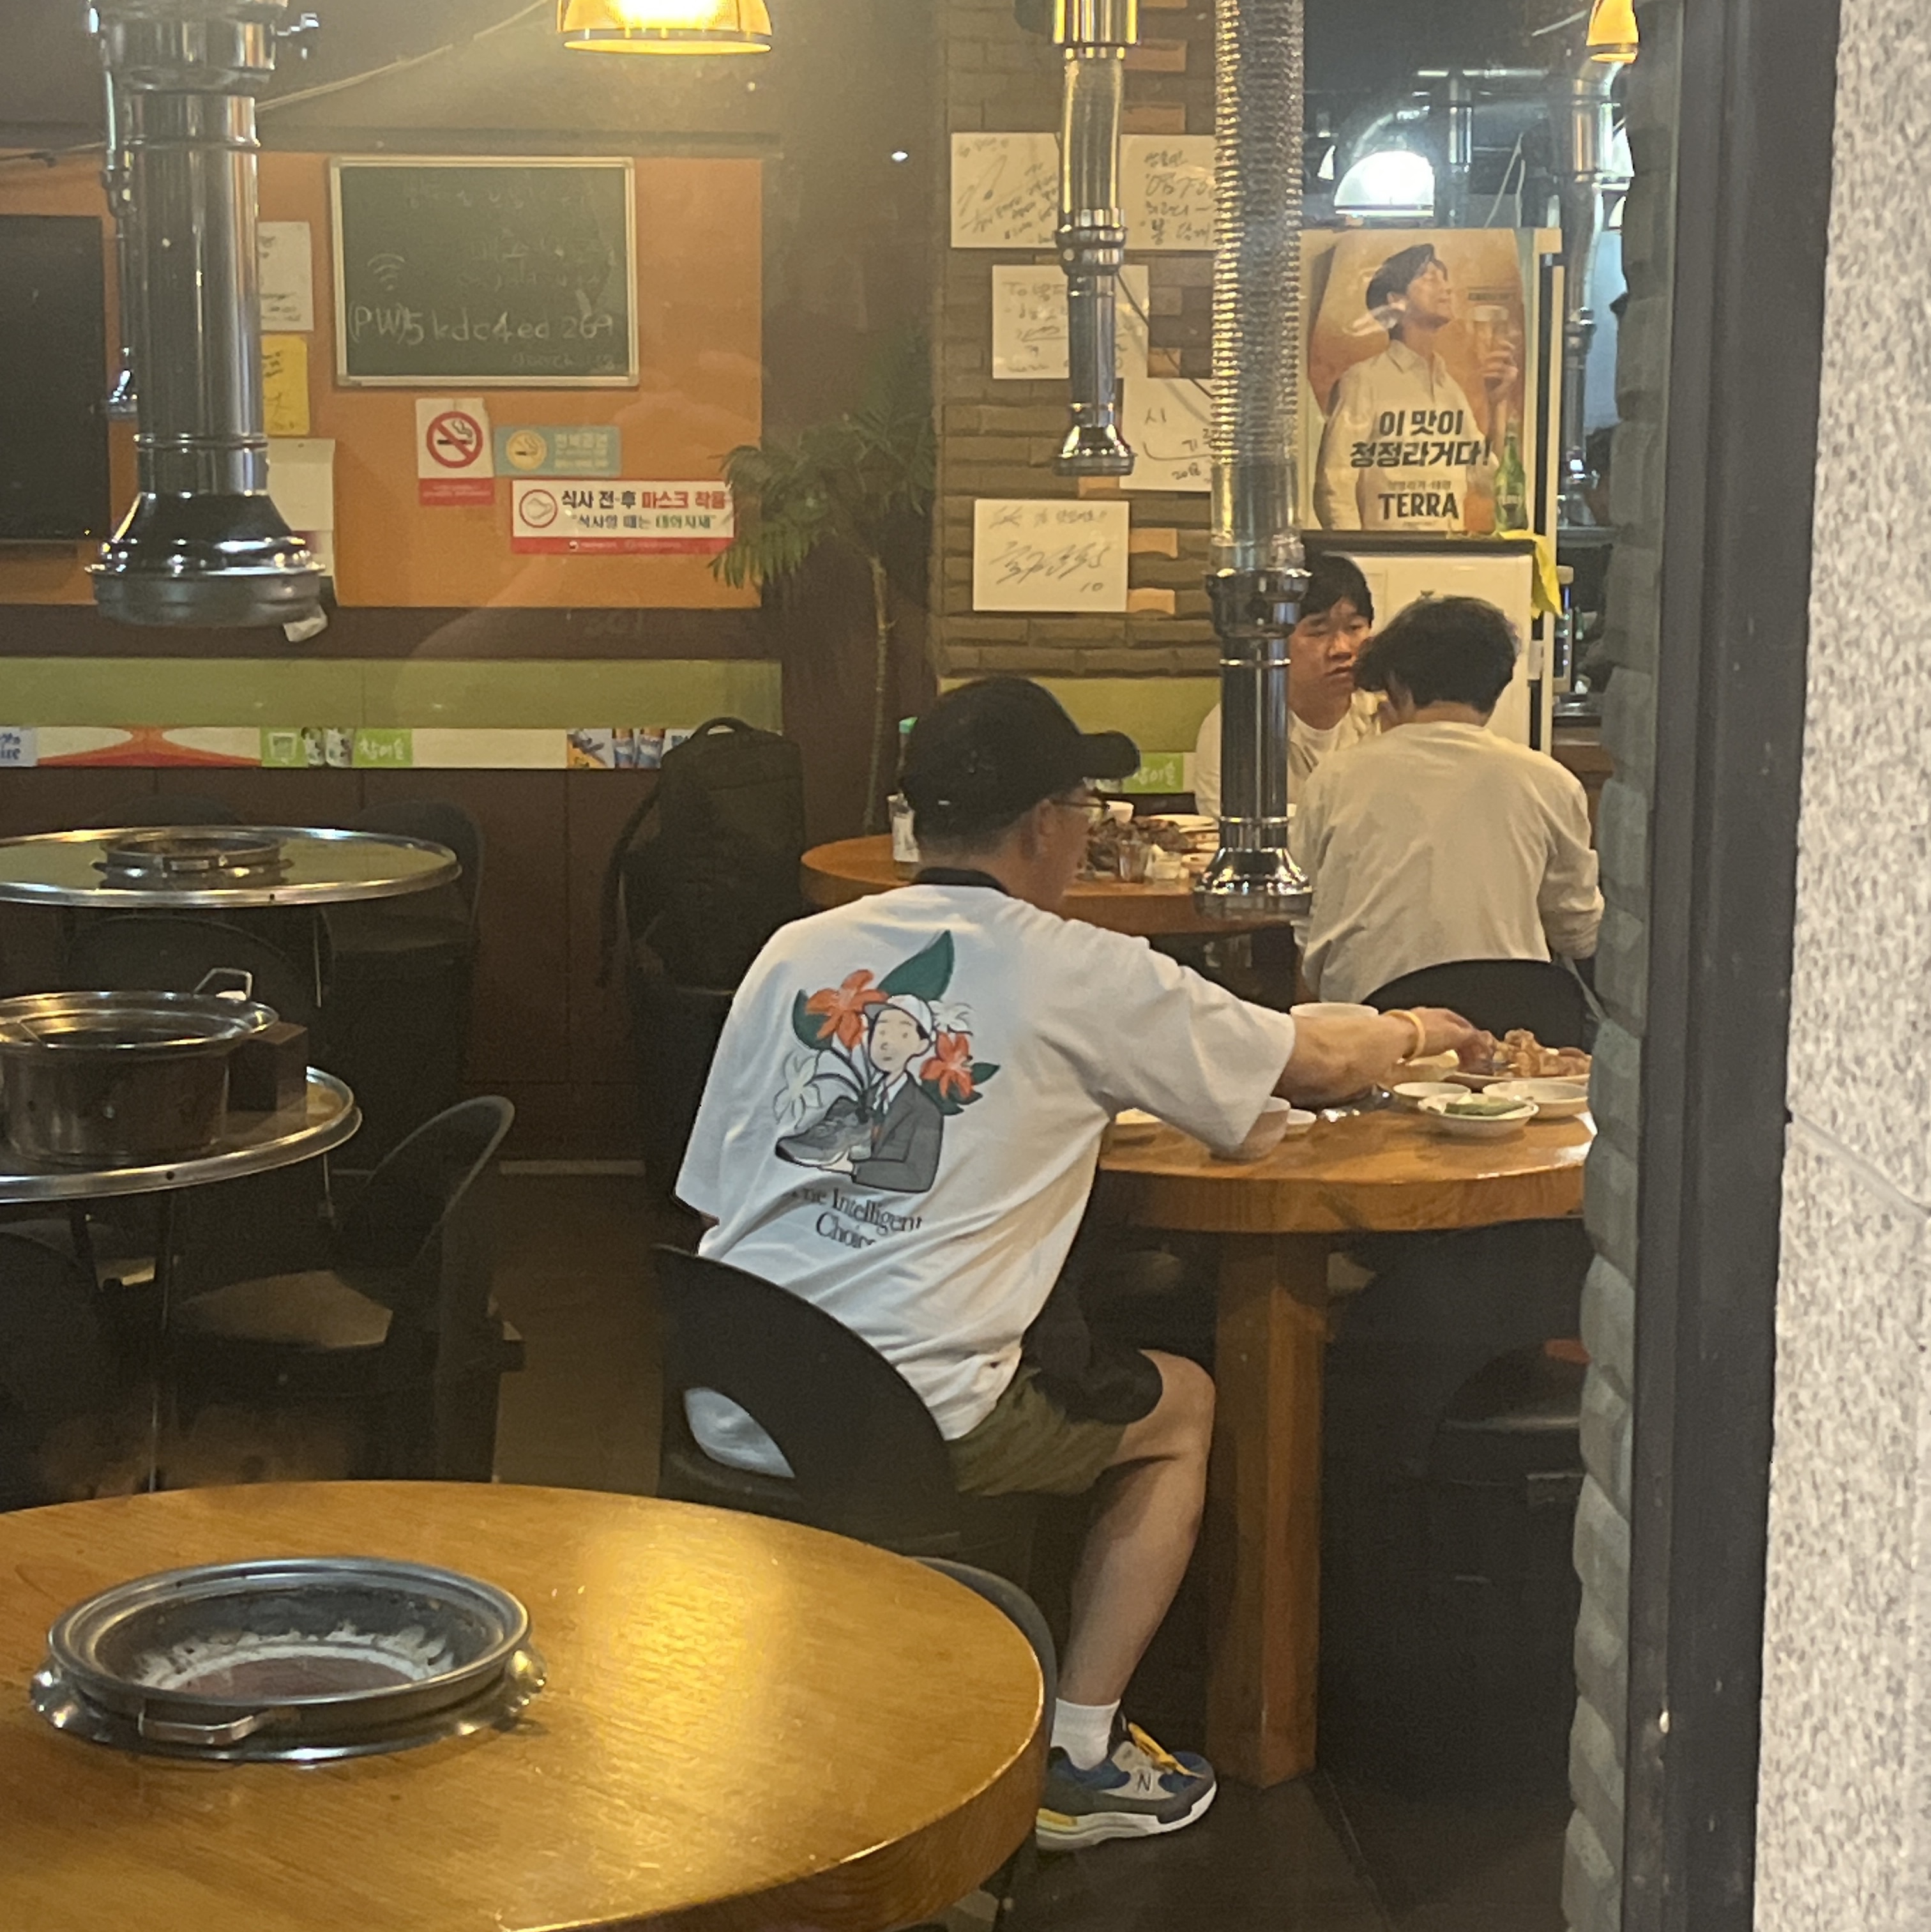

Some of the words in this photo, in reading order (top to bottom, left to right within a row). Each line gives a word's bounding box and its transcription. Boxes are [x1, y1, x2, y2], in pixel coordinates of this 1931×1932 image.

[1379, 410, 1405, 436] 이
[1410, 409, 1464, 436] 맛이
[1349, 440, 1492, 468] 청정라거다!
[561, 490, 594, 509] 식사
[641, 491, 689, 509] 마스크
[1378, 492, 1459, 520] TERRA
[1137, 1770, 1151, 1792] N
